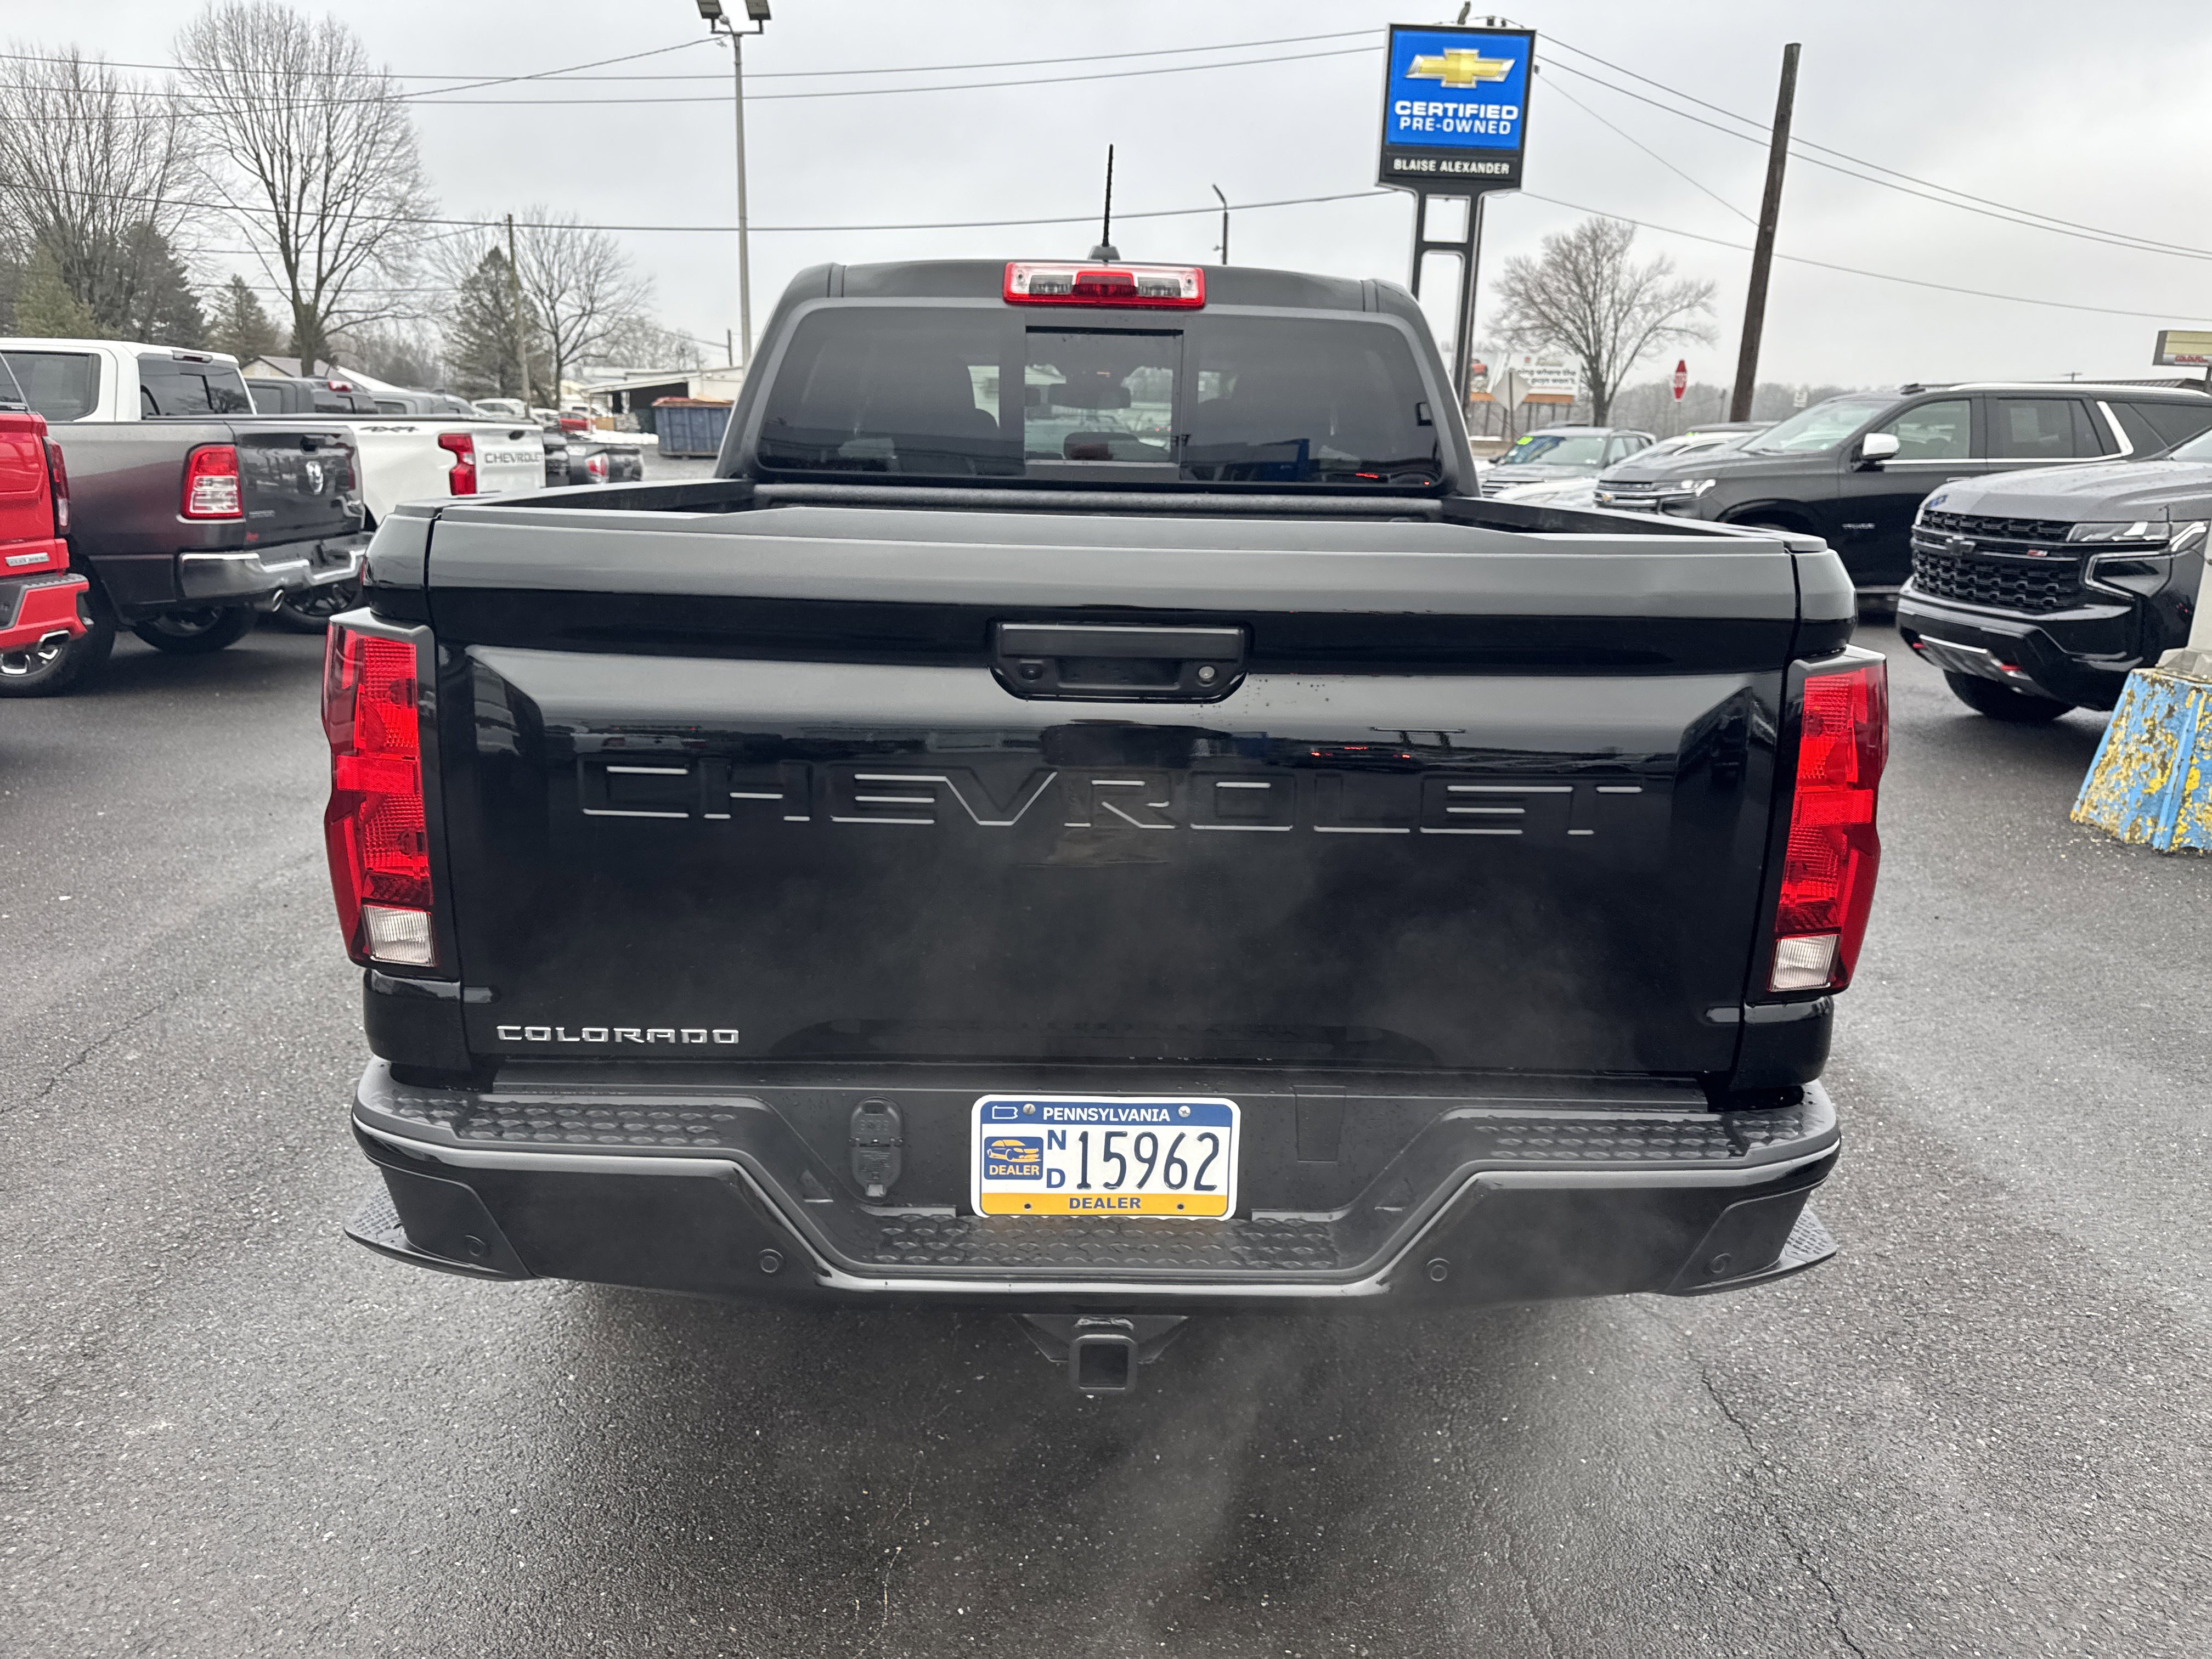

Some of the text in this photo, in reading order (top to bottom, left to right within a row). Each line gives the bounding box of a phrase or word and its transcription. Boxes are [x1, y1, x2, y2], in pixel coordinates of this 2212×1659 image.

[1395, 100, 1519, 120] CERTIFIED
[1399, 117, 1511, 135] PRE-OWNED
[1393, 158, 1510, 174] BLAISE ALEXANDER
[577, 754, 1643, 836] CHEVROLET
[496, 1026, 740, 1043] COLORADO
[1043, 1107, 1170, 1122] PENNSYLVANIA
[1047, 1130, 1066, 1150] N
[1076, 1131, 1220, 1191] 15962
[989, 1165, 1040, 1176] DEALER
[1046, 1168, 1066, 1188] D
[1069, 1197, 1142, 1209] DEALER
